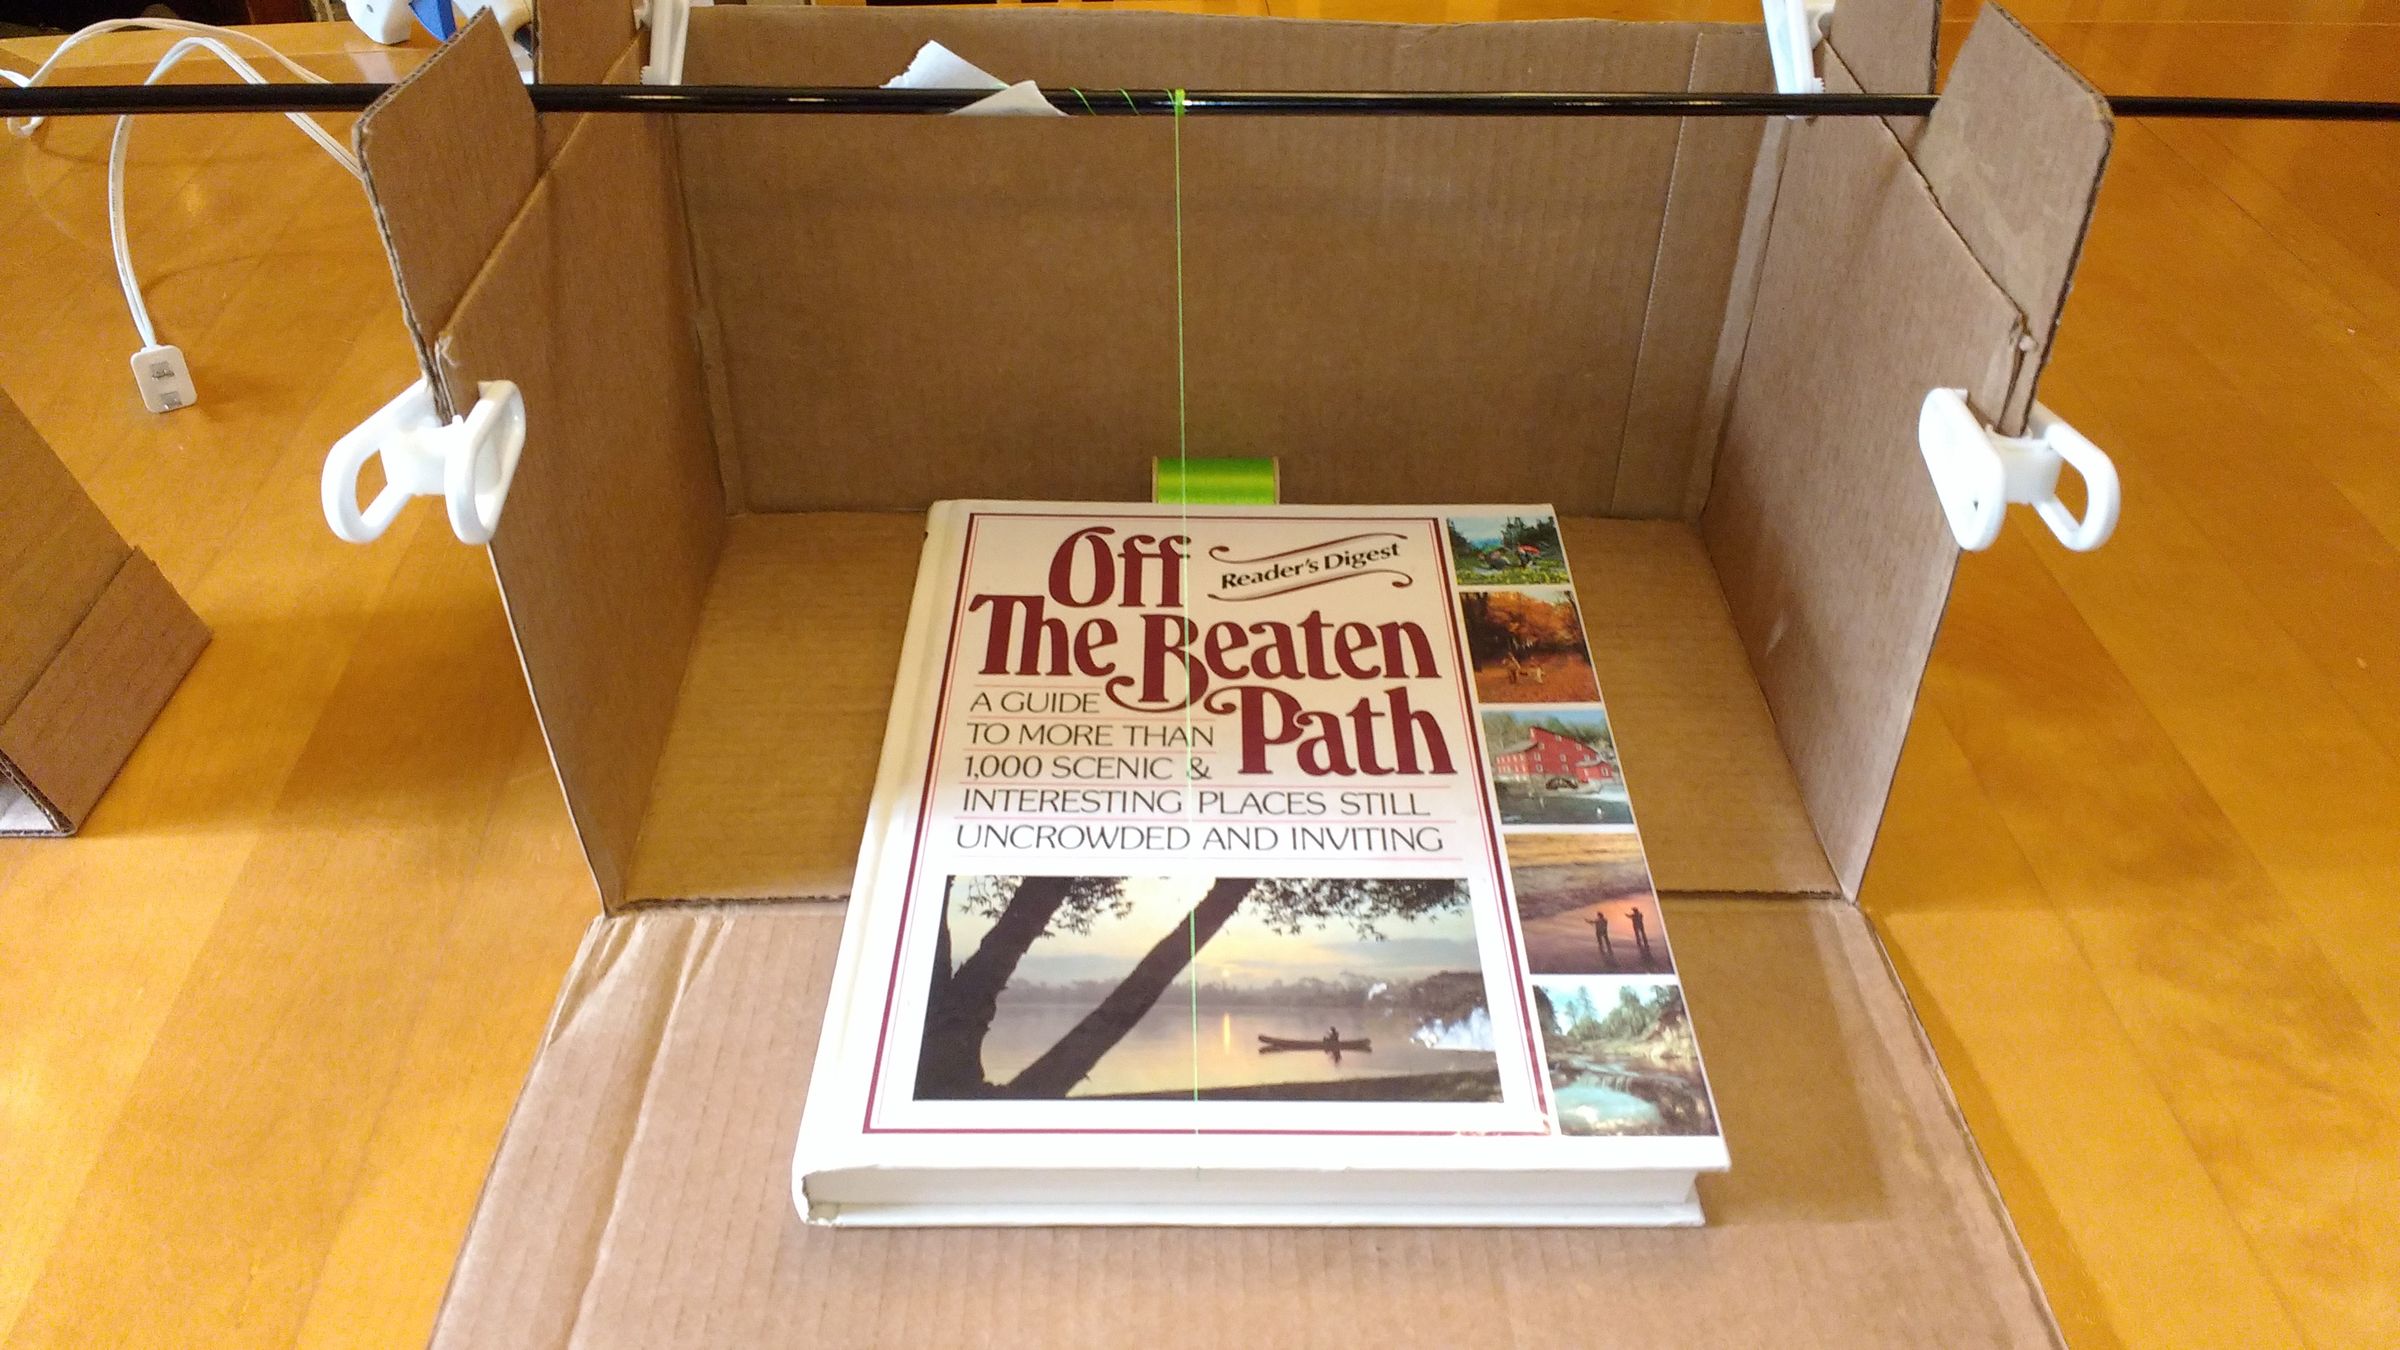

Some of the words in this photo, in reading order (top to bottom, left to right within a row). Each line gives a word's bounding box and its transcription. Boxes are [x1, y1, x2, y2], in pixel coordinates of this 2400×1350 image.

[1048, 525, 1192, 608] Off
[1220, 557, 1320, 590] Reader's
[1323, 540, 1401, 571] Digest
[968, 593, 1117, 677] The
[1105, 609, 1443, 713] Beaten
[969, 692, 993, 713] A
[1000, 692, 1100, 714] GUIDE
[966, 723, 1010, 746] TO
[1018, 723, 1114, 747] MORE
[1122, 724, 1214, 747] THAN
[1203, 686, 1458, 777] Path
[964, 756, 1043, 782] 1,000
[1050, 756, 1173, 781] SCENIC
[1186, 756, 1212, 781] &
[962, 788, 1183, 815] INTERESTING
[1198, 790, 1327, 816] PLACES
[1339, 792, 1431, 816] STILL
[955, 823, 1191, 851] UNCROWDED
[1201, 825, 1280, 852] AND
[1290, 826, 1444, 853] INVITING
